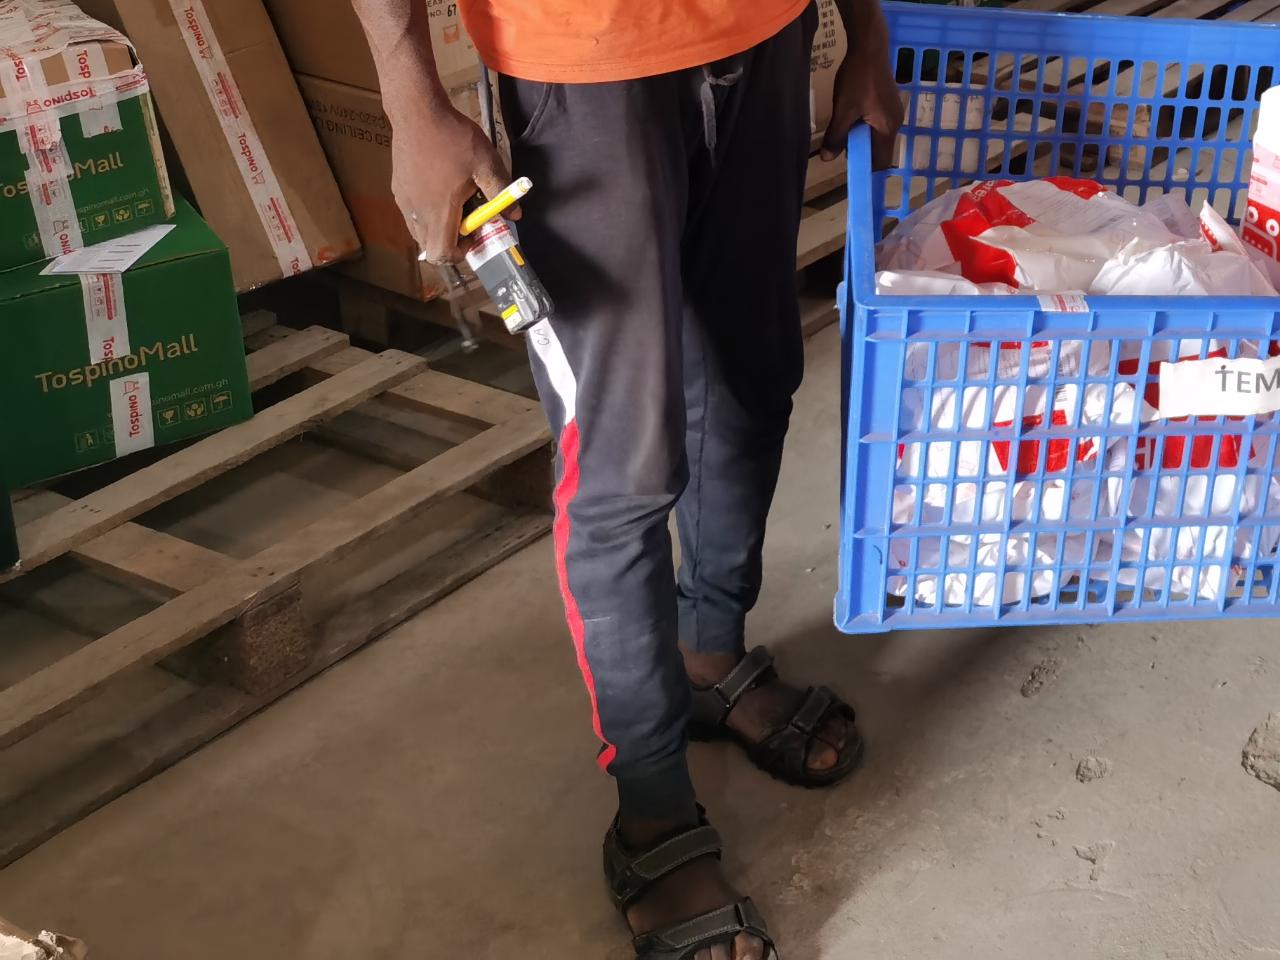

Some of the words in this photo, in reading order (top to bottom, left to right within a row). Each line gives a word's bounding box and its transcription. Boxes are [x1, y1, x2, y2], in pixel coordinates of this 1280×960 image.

[43, 87, 97, 108] Tospino
[35, 333, 199, 392] TospinoMall
[129, 395, 143, 438] Tospino
